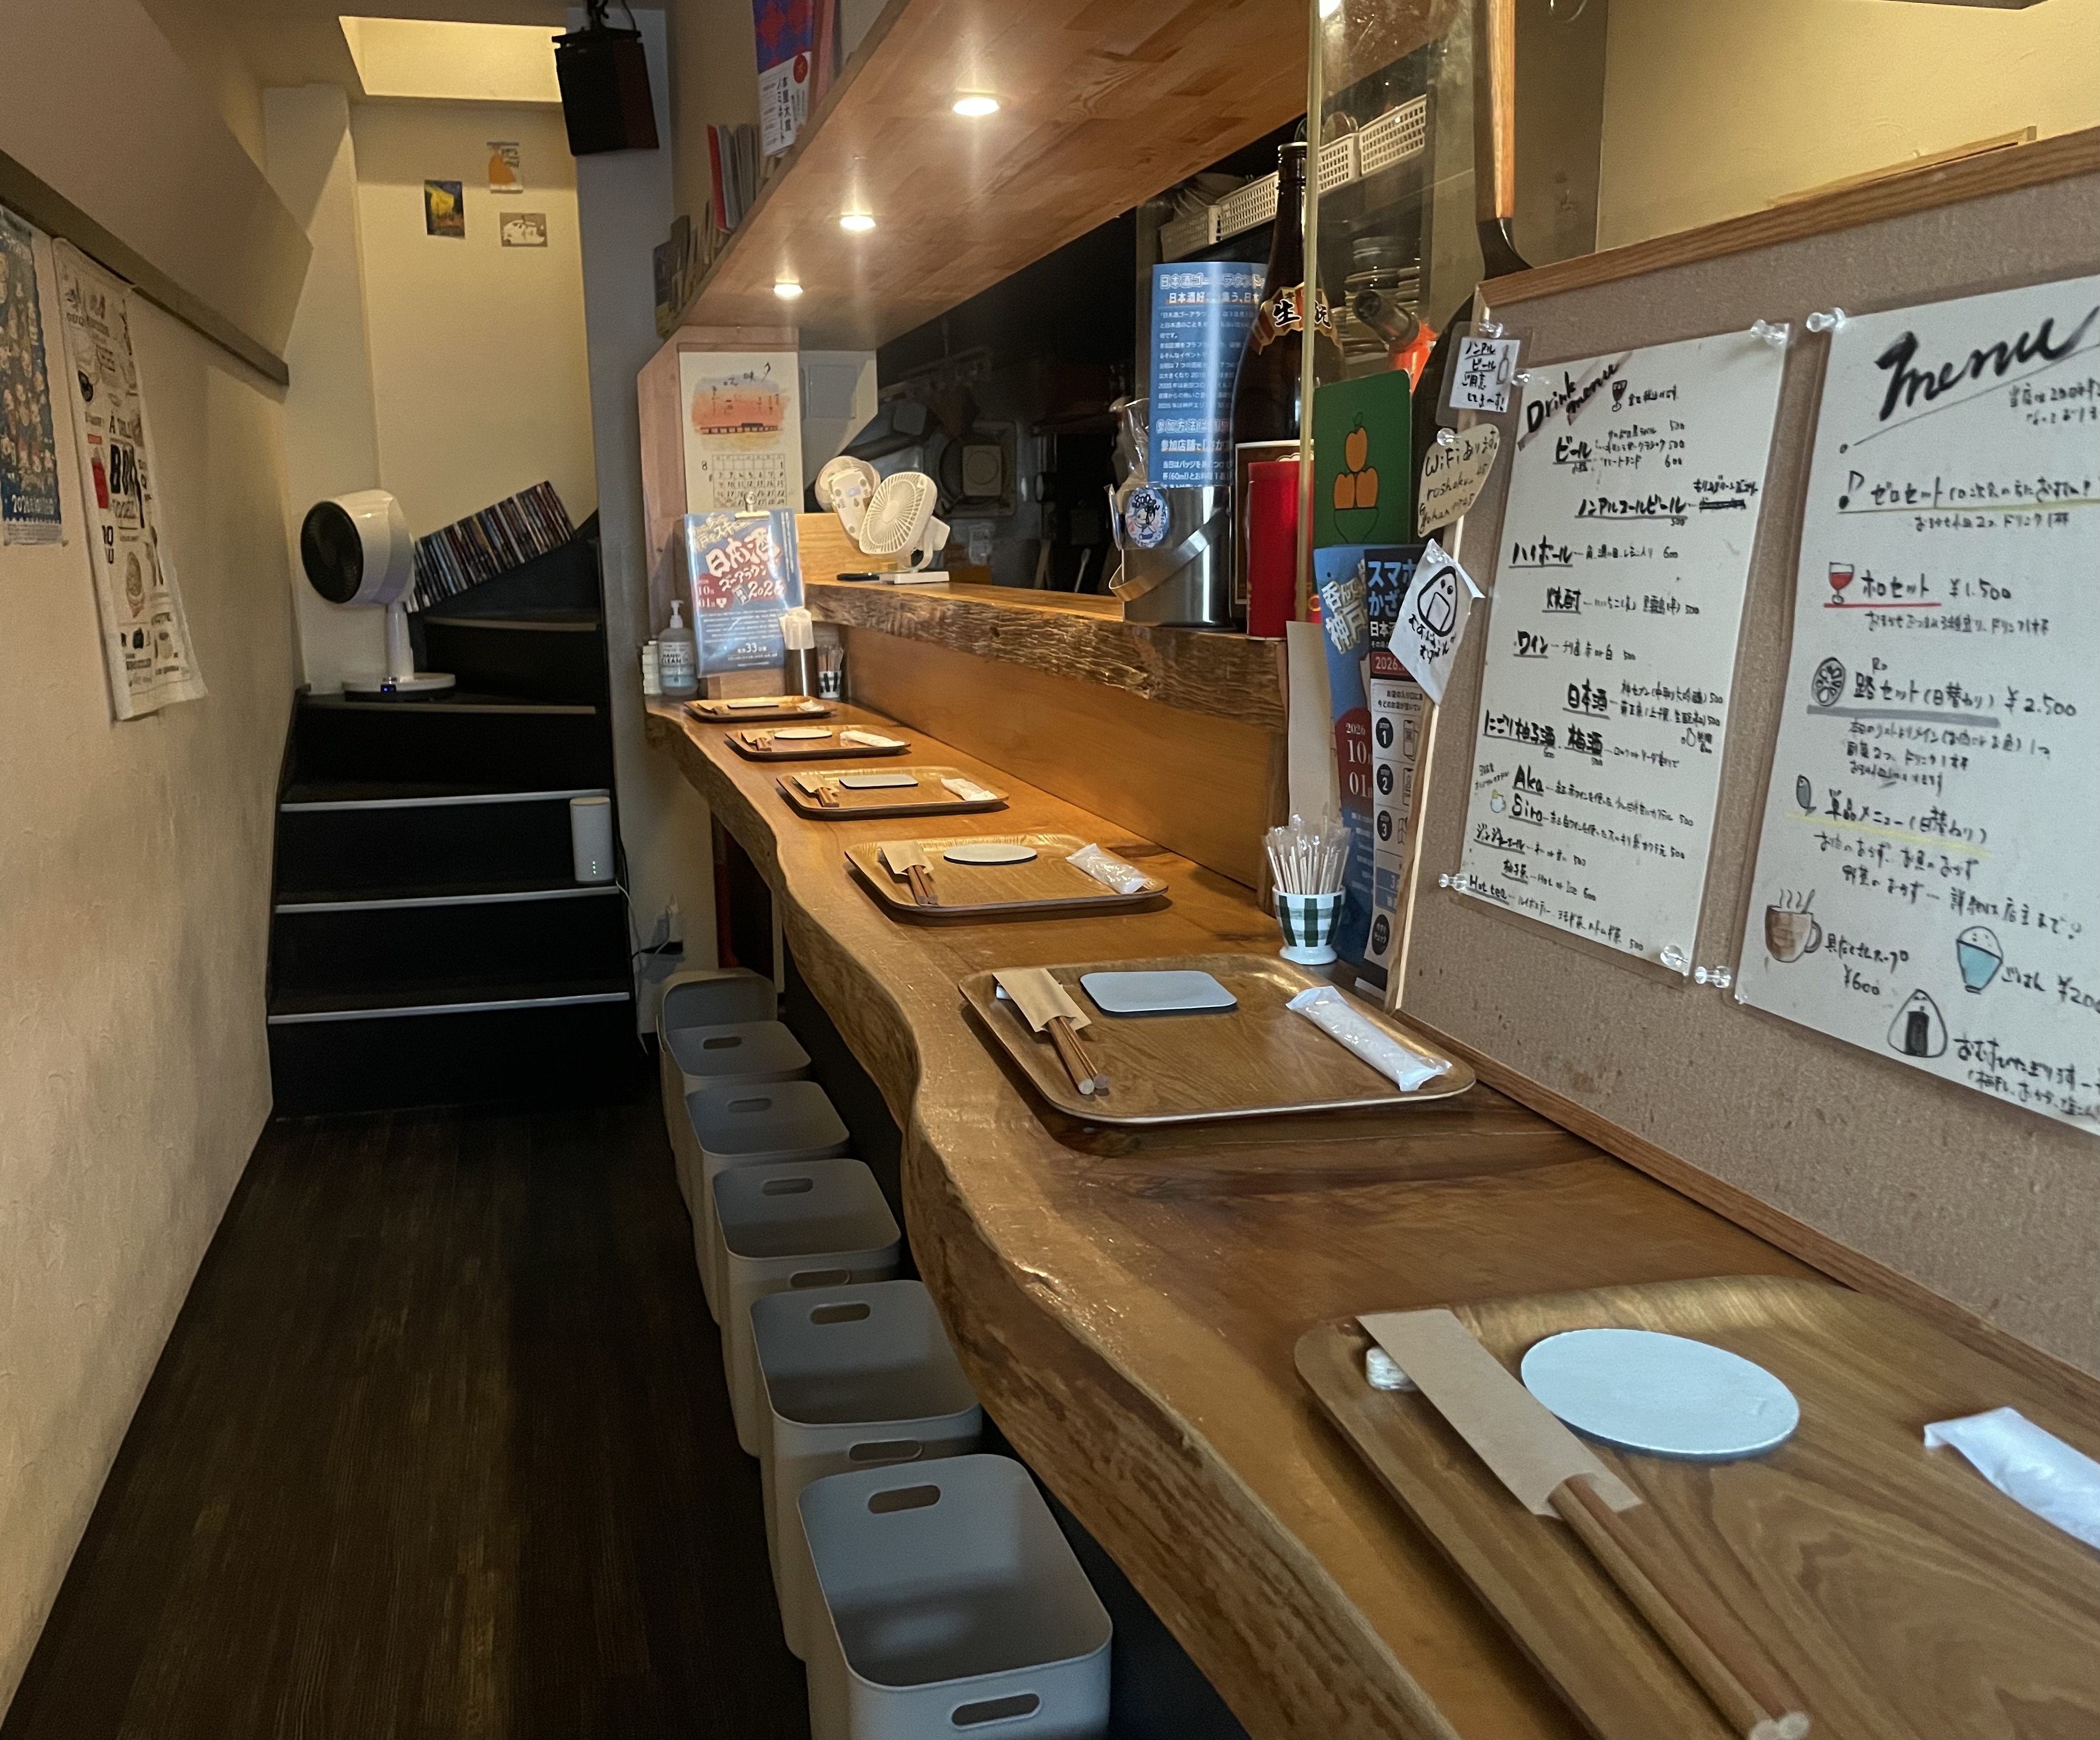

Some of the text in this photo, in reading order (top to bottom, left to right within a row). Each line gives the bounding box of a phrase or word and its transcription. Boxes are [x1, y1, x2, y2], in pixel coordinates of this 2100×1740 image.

[1465, 341, 1496, 354] ノンアル
[1472, 358, 1496, 371] ビール
[1526, 372, 1576, 433] Drink
[1556, 436, 1592, 463] ビール
[1669, 440, 1685, 450] 500
[1664, 454, 1682, 468] 600
[1577, 493, 1686, 516] ノンアルコールビール
[1670, 518, 1685, 527] 500
[705, 527, 781, 578] 日本酒
[1512, 535, 1573, 567] ハイボール
[1860, 570, 1930, 598] ホロセット
[1369, 590, 1407, 617] かざ
[1517, 629, 1549, 655] ワイン
[1568, 678, 1608, 713] 日本酒
[1709, 691, 1724, 704] 500
[1346, 722, 1366, 735] 2026
[1707, 715, 1721, 727] 500
[1382, 730, 1387, 745] 1
[1382, 777, 1388, 792] 2
[1513, 764, 1544, 792] Aka
[1679, 814, 1694, 827] 500
[1381, 823, 1388, 838] 3
[1670, 845, 1686, 860] 500
[1469, 875, 1488, 893] Hot
[1490, 884, 1507, 900] tea
[1843, 964, 1880, 995] ¥600
